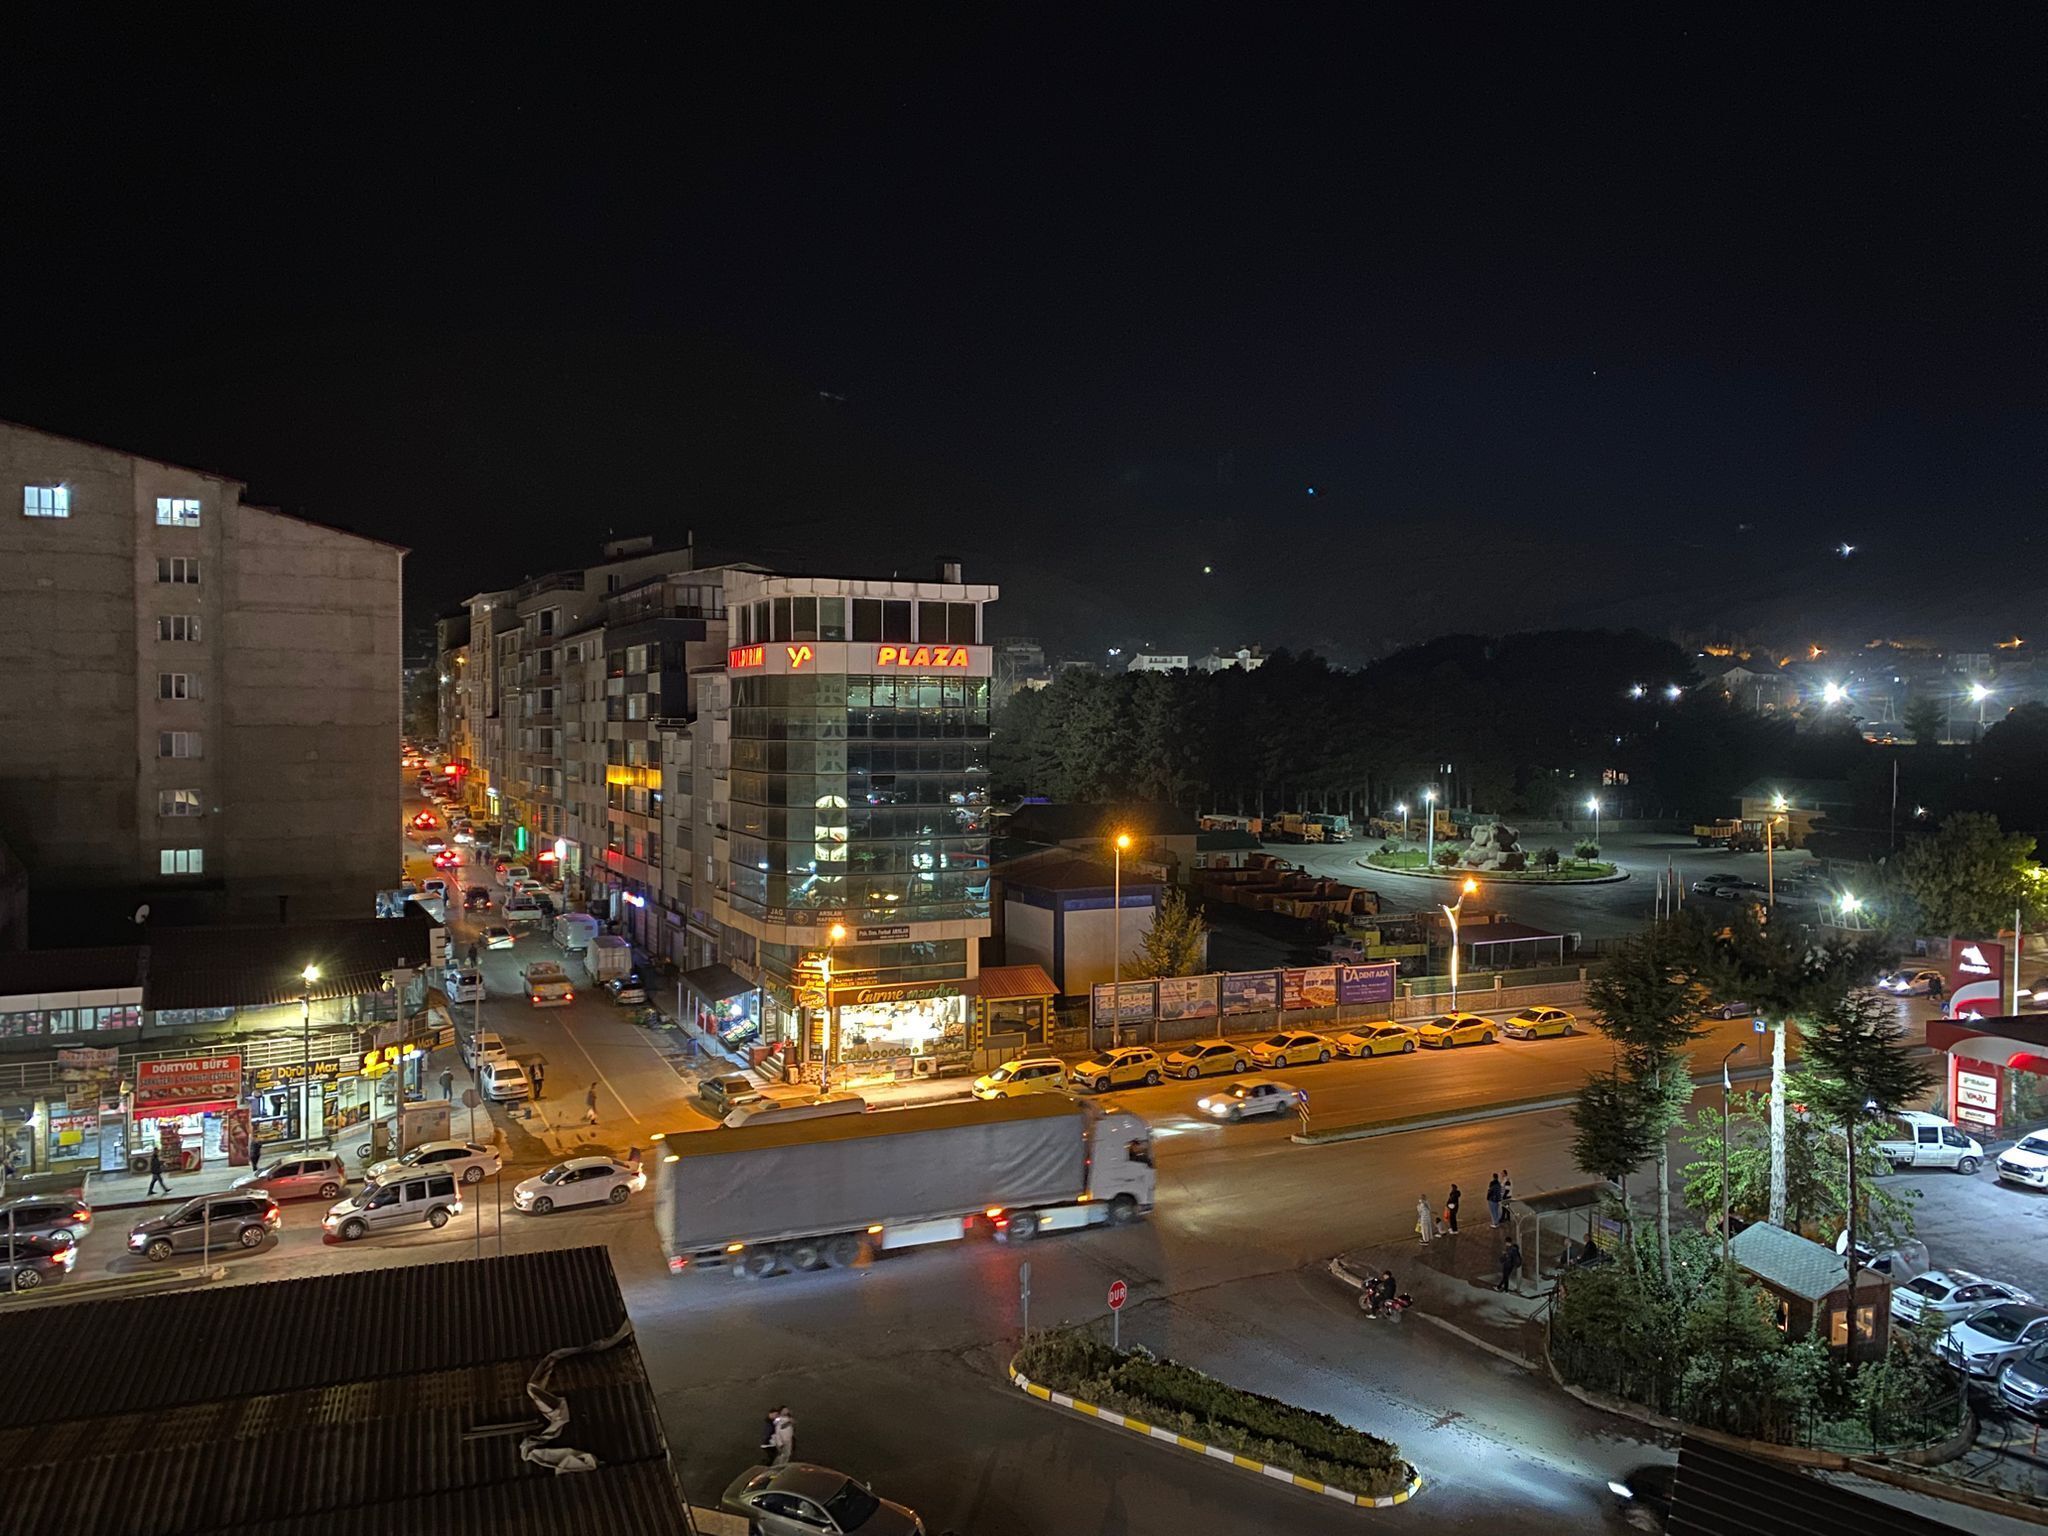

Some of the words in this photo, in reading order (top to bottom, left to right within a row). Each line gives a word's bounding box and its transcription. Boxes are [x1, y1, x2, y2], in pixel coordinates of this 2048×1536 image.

[730, 646, 764, 668] YILDIRIM
[877, 646, 969, 667] PLAZA
[1360, 971, 1375, 979] DENT
[1376, 970, 1390, 978] ADA
[857, 989, 904, 1004] Gurme
[152, 1061, 199, 1074] DÖRTYOL
[202, 1058, 230, 1070] BÜFE
[315, 1061, 338, 1073] Max
[1110, 1287, 1125, 1302] DUR
